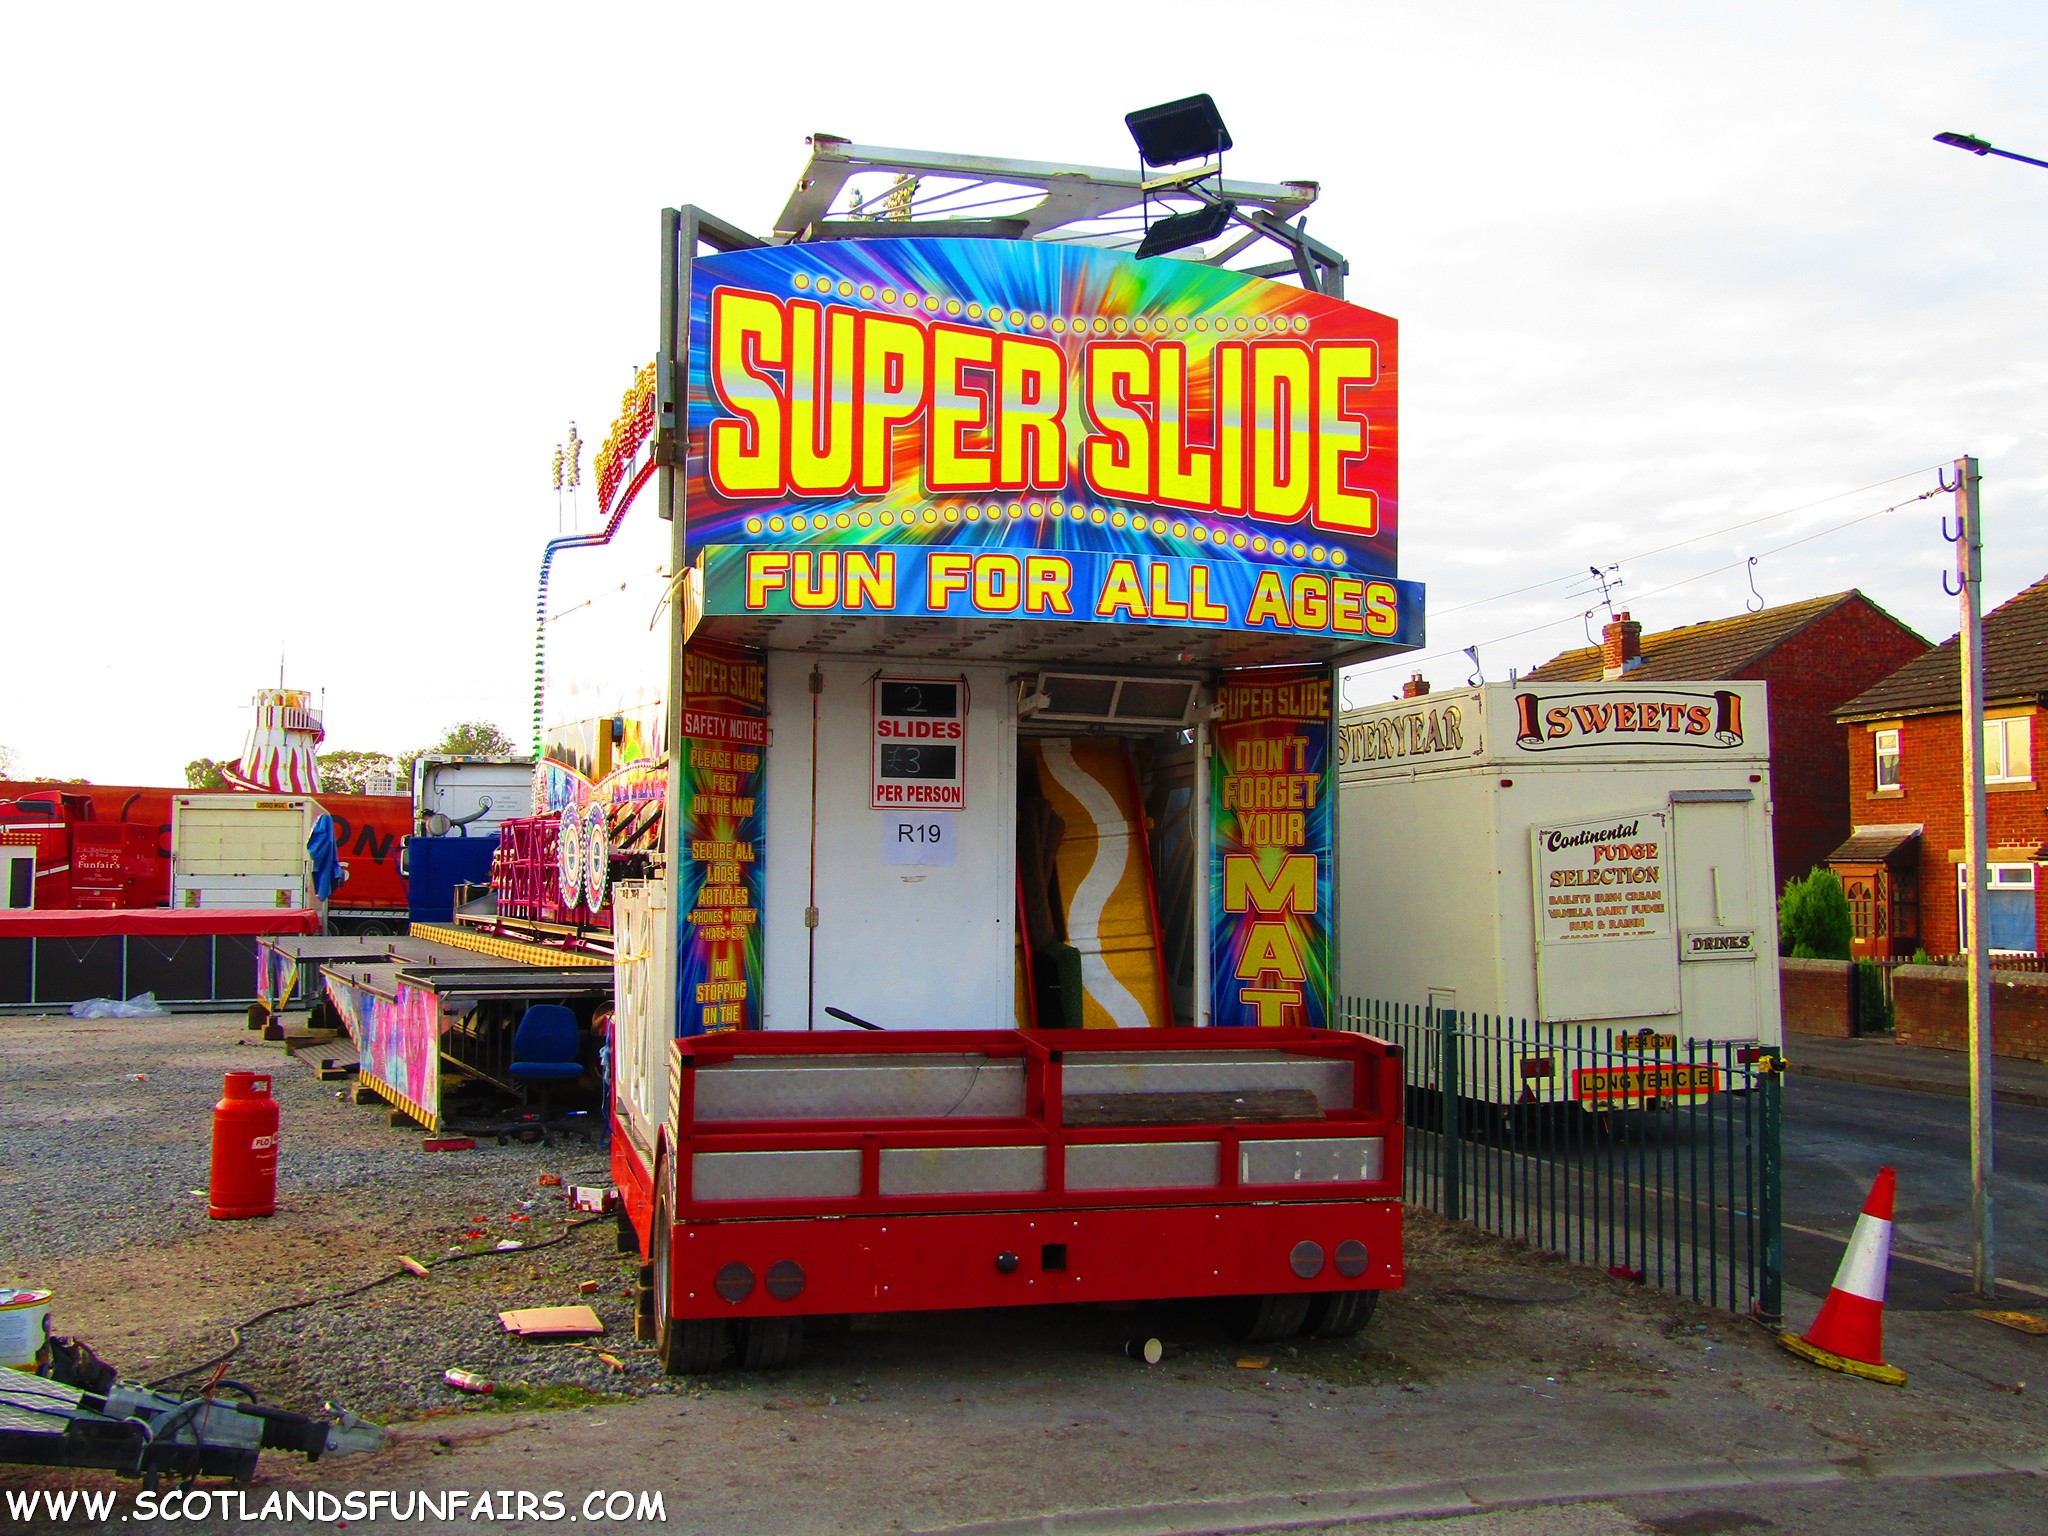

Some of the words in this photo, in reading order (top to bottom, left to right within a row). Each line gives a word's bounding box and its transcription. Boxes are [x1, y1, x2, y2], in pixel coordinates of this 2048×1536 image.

[712, 286, 1067, 499] SUPER
[1083, 339, 1379, 537] SLIDE
[745, 552, 896, 610] FUN
[926, 553, 1073, 615] FOR
[1097, 558, 1227, 623] ALL
[1244, 576, 1399, 637] AGES
[685, 653, 728, 693] SUPER
[730, 665, 765, 704] SLIDE
[904, 685, 927, 712] 2
[1218, 688, 1273, 720] SUPER
[1278, 680, 1331, 718] SLIDE
[685, 713, 727, 737] SAFETY
[730, 719, 764, 741] NOTICE
[877, 720, 961, 739] SLIDES
[1547, 702, 1712, 740] SWEETS
[690, 747, 731, 771] PLEASE
[733, 751, 759, 773] KEEP
[887, 746, 921, 774] £3
[1234, 733, 1309, 773] DON'T
[712, 774, 738, 793] FEET
[877, 785, 903, 802] PER
[907, 786, 960, 803] PERSON
[1222, 773, 1320, 810] FORGET
[694, 795, 708, 814] ON
[711, 795, 730, 815] THE
[732, 797, 755, 817] MAT
[898, 824, 941, 843] R19
[1236, 811, 1305, 848] YOUR
[1547, 820, 1639, 852] Continental
[692, 841, 732, 860] SECURE
[735, 842, 755, 862] ALL
[1593, 843, 1659, 865] FUDGE
[78, 861, 121, 869] Funfair's
[706, 864, 740, 883] LOOSE
[1550, 866, 1660, 888] SELECTION
[698, 887, 749, 906] ARTICLES
[1549, 893, 1591, 905] BAILEYS
[1595, 892, 1622, 903] IRISH
[1625, 891, 1661, 901] CREAM
[693, 909, 723, 925] PHONES
[731, 909, 757, 924] MONEY
[1548, 908, 1593, 919] VANILLA
[1596, 905, 1628, 917] DAIRY
[1631, 904, 1664, 914] FUDGE
[705, 926, 725, 940] HATS
[731, 925, 746, 940] ETC
[1569, 920, 1593, 931] RUM
[1597, 920, 1605, 930] &
[1609, 918, 1644, 930] RAISIN
[1223, 854, 1318, 1027] MAT
[1692, 935, 1750, 950] DRINKS
[715, 960, 729, 979] NO
[696, 981, 747, 1003] STOPPING
[703, 1005, 718, 1025] ON
[720, 1003, 740, 1024] THE
[1583, 1075, 1631, 1091] LONG
[1635, 1070, 1709, 1089] VEHCE
